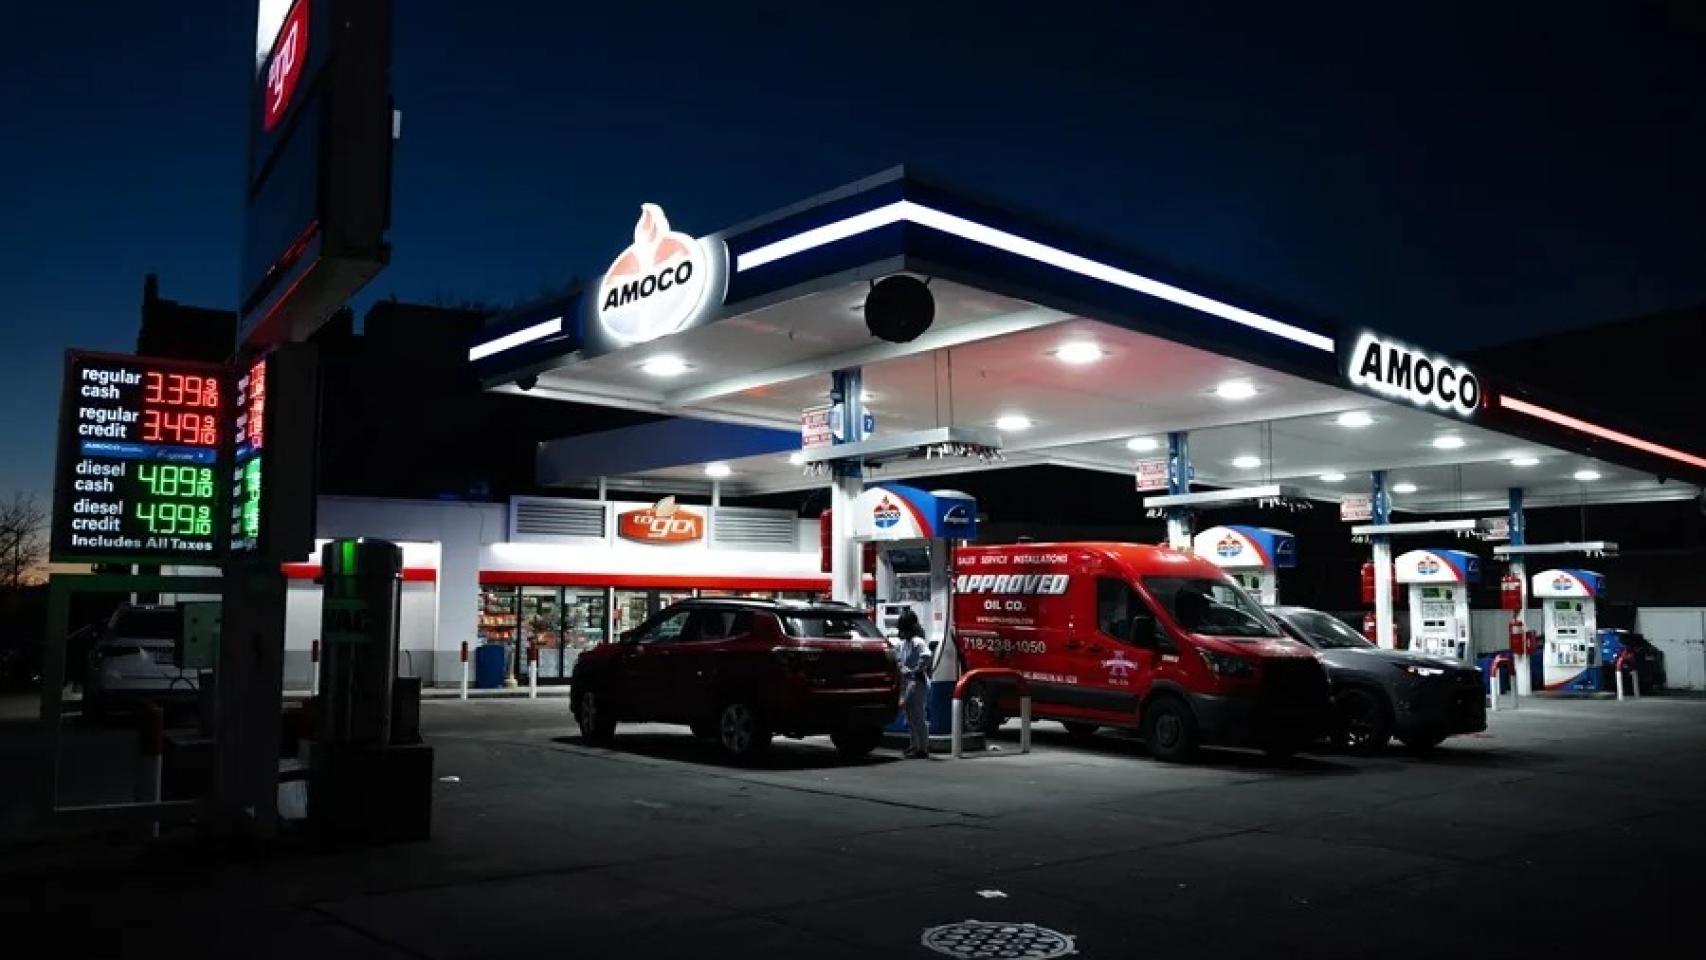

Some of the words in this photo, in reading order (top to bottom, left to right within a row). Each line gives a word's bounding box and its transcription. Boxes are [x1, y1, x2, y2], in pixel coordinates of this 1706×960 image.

[603, 260, 693, 312] AMOCO
[1359, 342, 1478, 409] AMOCO
[81, 384, 120, 399] cash
[82, 368, 142, 385] regular
[145, 372, 202, 406] 3.39
[78, 422, 127, 438] credit
[79, 406, 139, 423] regular
[143, 409, 200, 443] 3.49
[74, 478, 114, 493] cash
[75, 460, 126, 477] diesel
[138, 464, 197, 496] 4.89
[72, 514, 121, 532] credit
[73, 499, 124, 515] diesel
[136, 502, 195, 534] 4.99
[72, 534, 142, 549] Includes
[146, 537, 168, 550] All
[171, 538, 213, 551] Taxes
[953, 574, 1070, 595] APPROVED
[984, 599, 1002, 610] OIL
